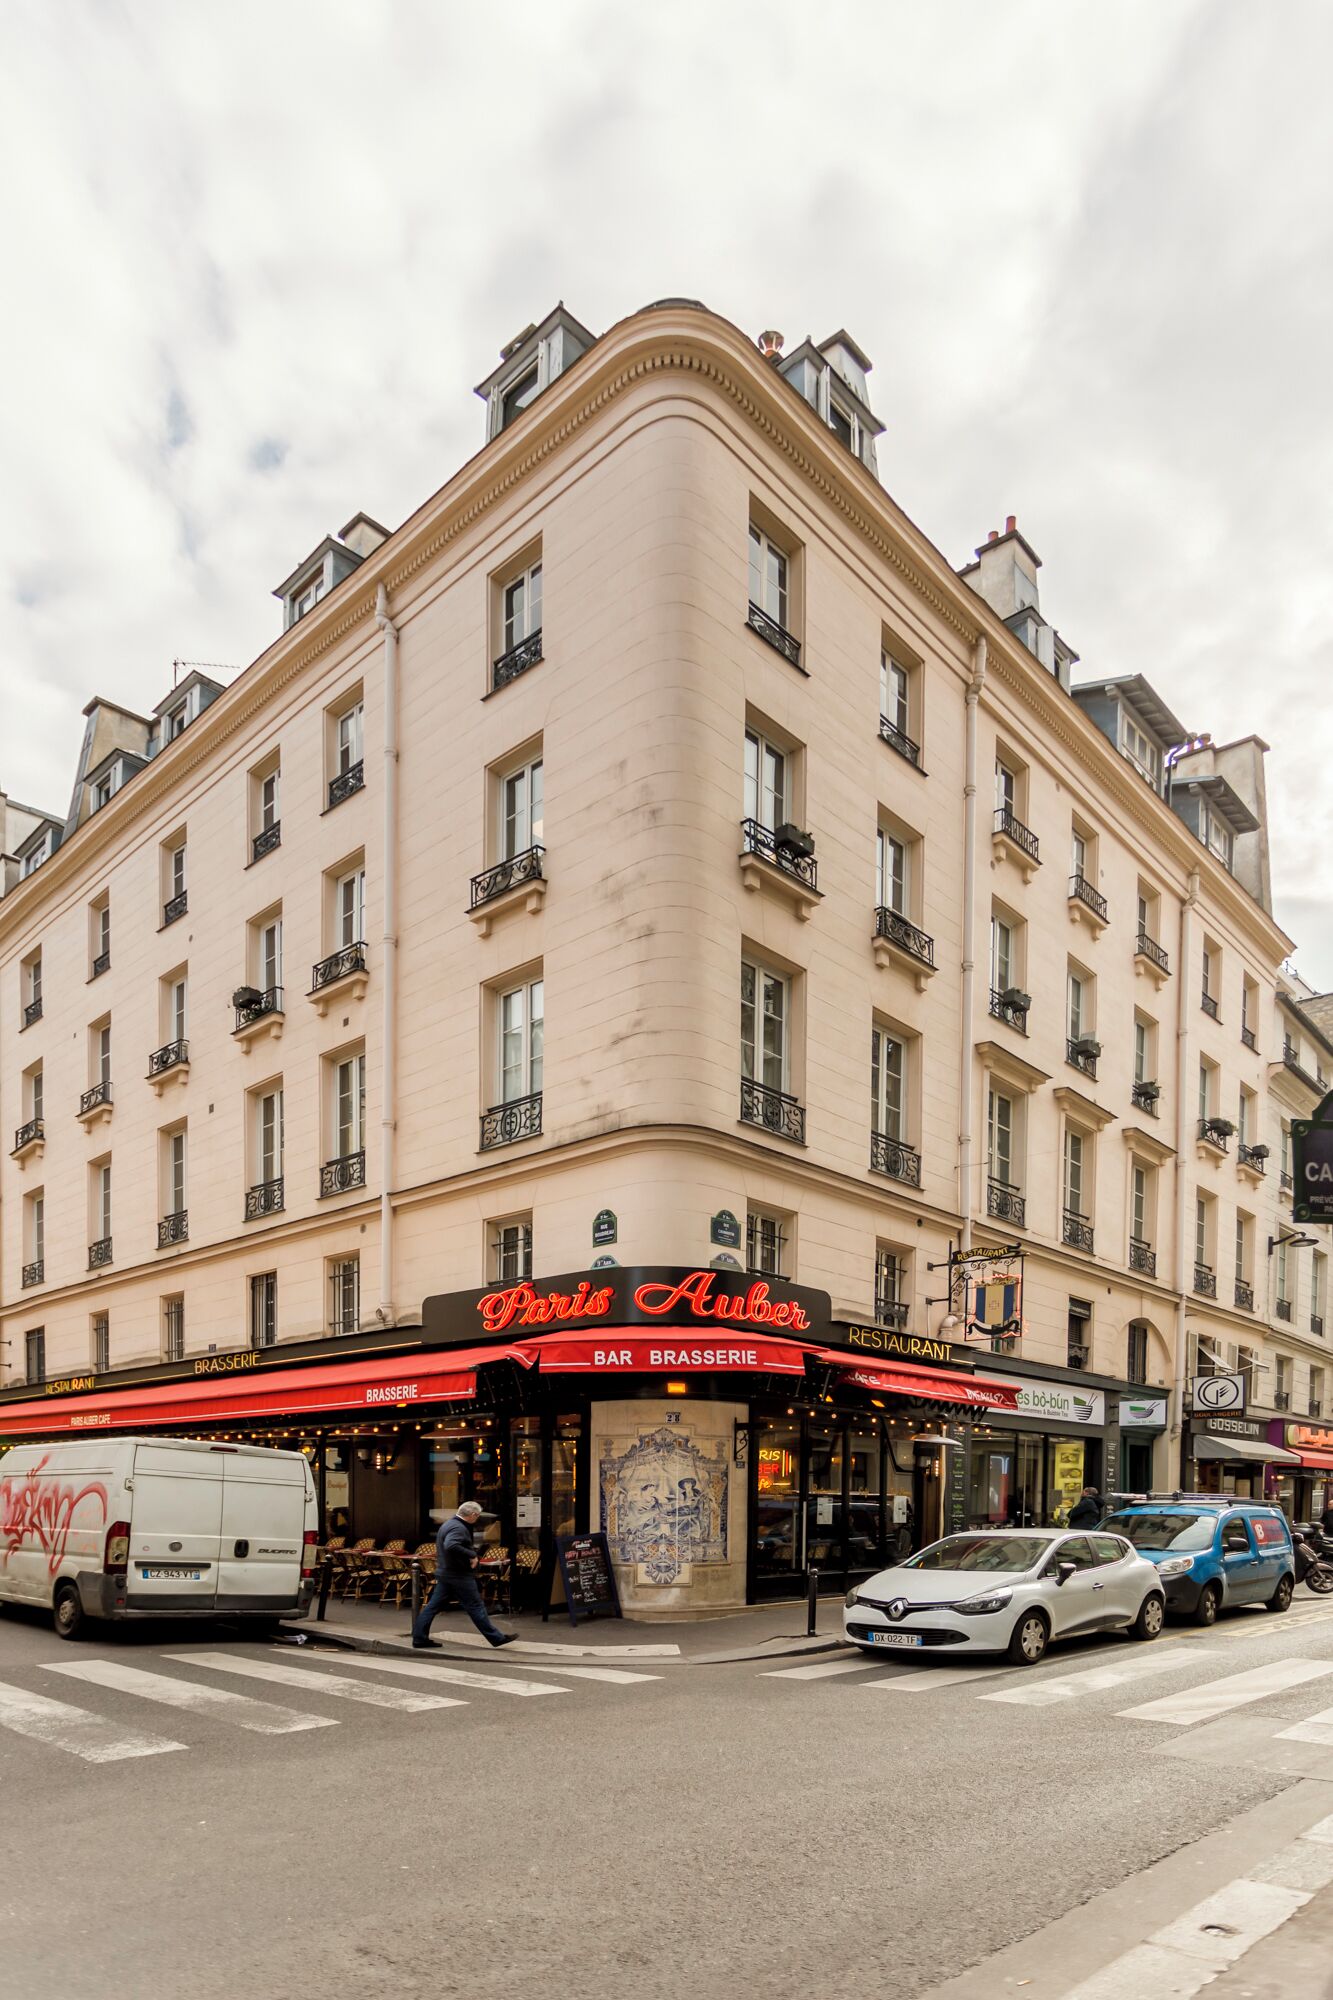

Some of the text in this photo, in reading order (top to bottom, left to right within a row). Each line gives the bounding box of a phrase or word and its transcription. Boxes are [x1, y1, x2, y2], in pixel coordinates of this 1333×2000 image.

[957, 1247, 1009, 1262] RESTAURANT
[477, 1272, 811, 1332] Paris Auber
[849, 1326, 952, 1361] RESTAURANT
[194, 1351, 261, 1375] BRASSERIE
[594, 1350, 758, 1366] BAR BRASSERIE
[45, 1376, 96, 1395] RESTAURANT
[366, 1384, 418, 1403] BRASSERIE
[71, 1416, 84, 1427] PARIS
[84, 1414, 98, 1426] AUBER
[667, 1414, 680, 1422] 28
[1194, 1410, 1242, 1418] BOULANGERIE
[1209, 1418, 1260, 1436] GOSSELIN
[1254, 1523, 1265, 1540] B
